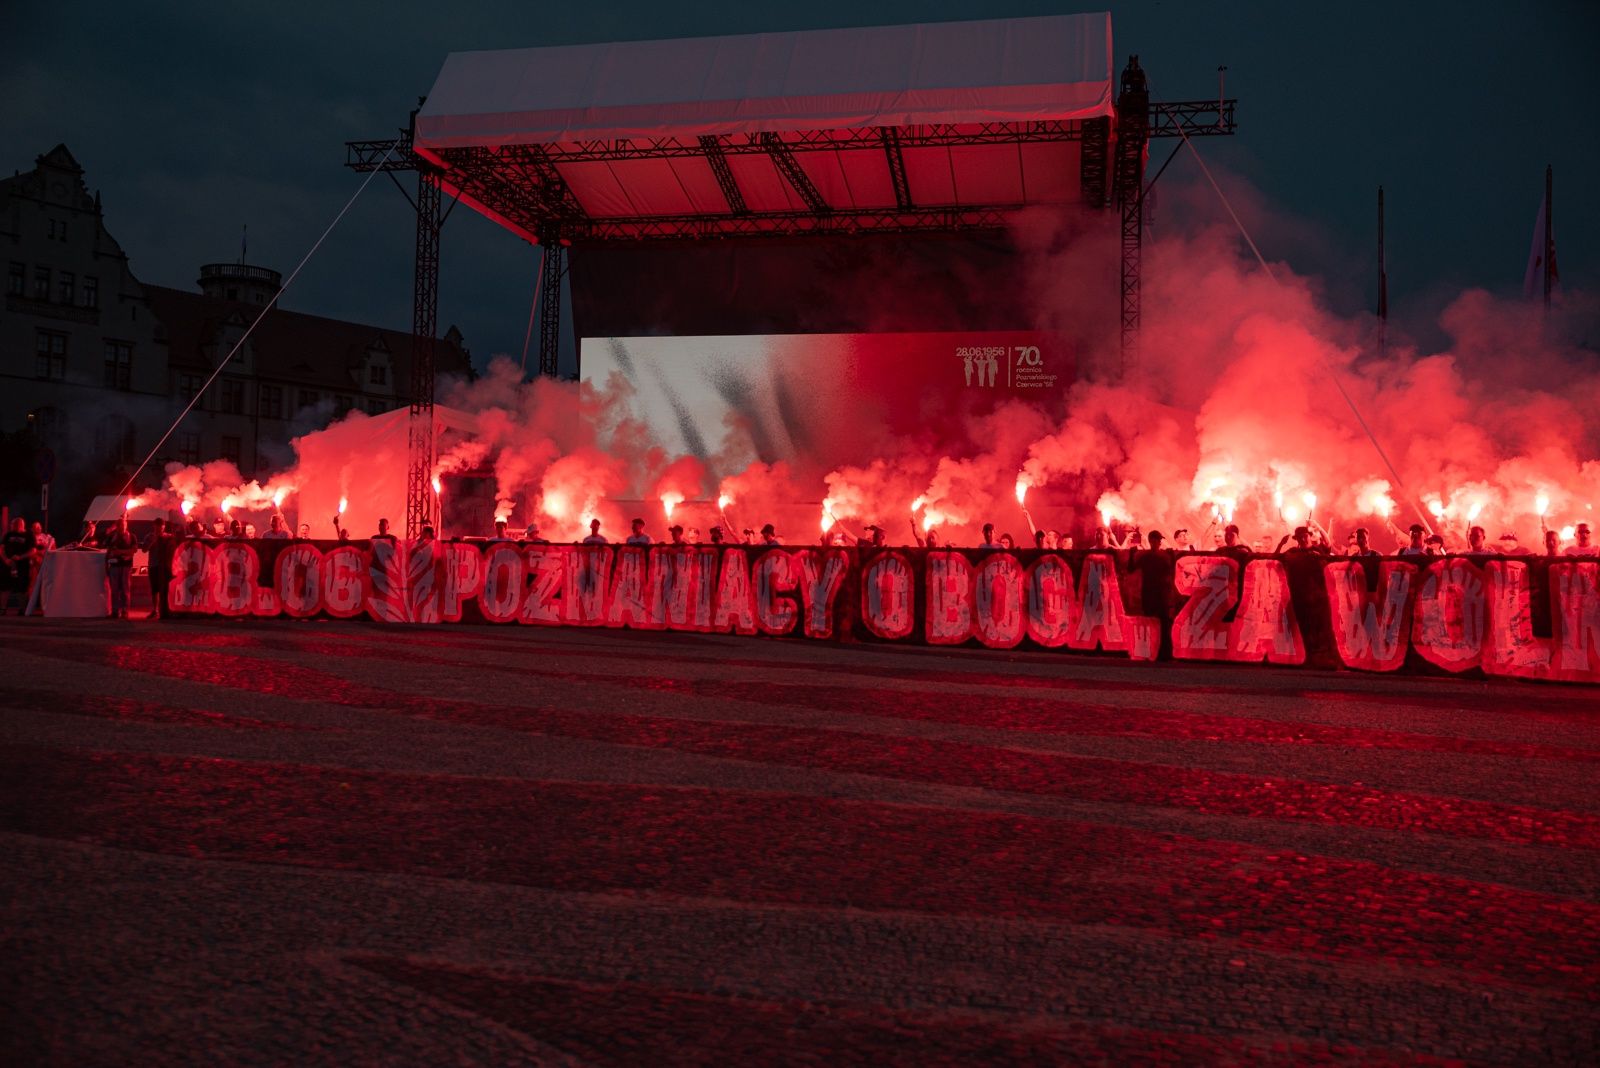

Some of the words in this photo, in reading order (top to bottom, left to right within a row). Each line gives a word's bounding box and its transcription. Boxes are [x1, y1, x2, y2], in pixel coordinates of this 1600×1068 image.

[955, 346, 1005, 357] 28.06.1956
[1015, 345, 1044, 366] 70.
[169, 543, 368, 617] 28.06
[441, 543, 848, 637] POZNANIACY
[862, 551, 914, 639] O
[1172, 556, 1306, 664] ZA
